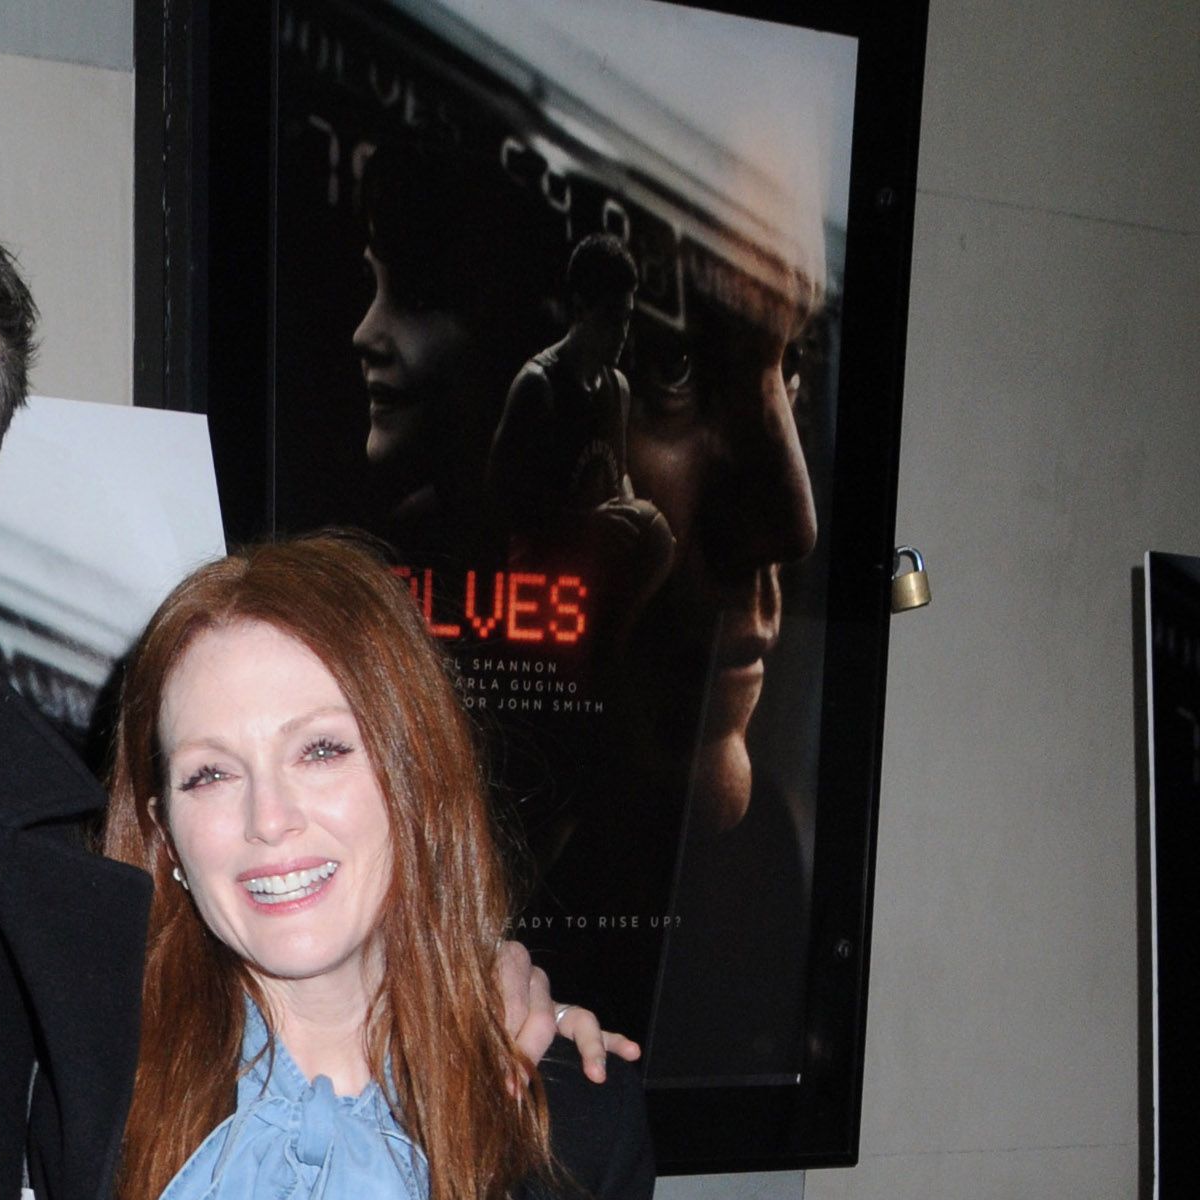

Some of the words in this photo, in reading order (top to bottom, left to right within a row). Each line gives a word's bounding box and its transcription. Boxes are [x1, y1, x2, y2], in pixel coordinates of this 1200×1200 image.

[472, 658, 558, 674] SHANNON
[510, 679, 578, 694] GUGINO
[497, 697, 543, 711] JOHN
[553, 699, 604, 713] SMITH
[564, 916, 587, 929] TO
[598, 916, 640, 929] RISE
[650, 916, 682, 929] UP?
